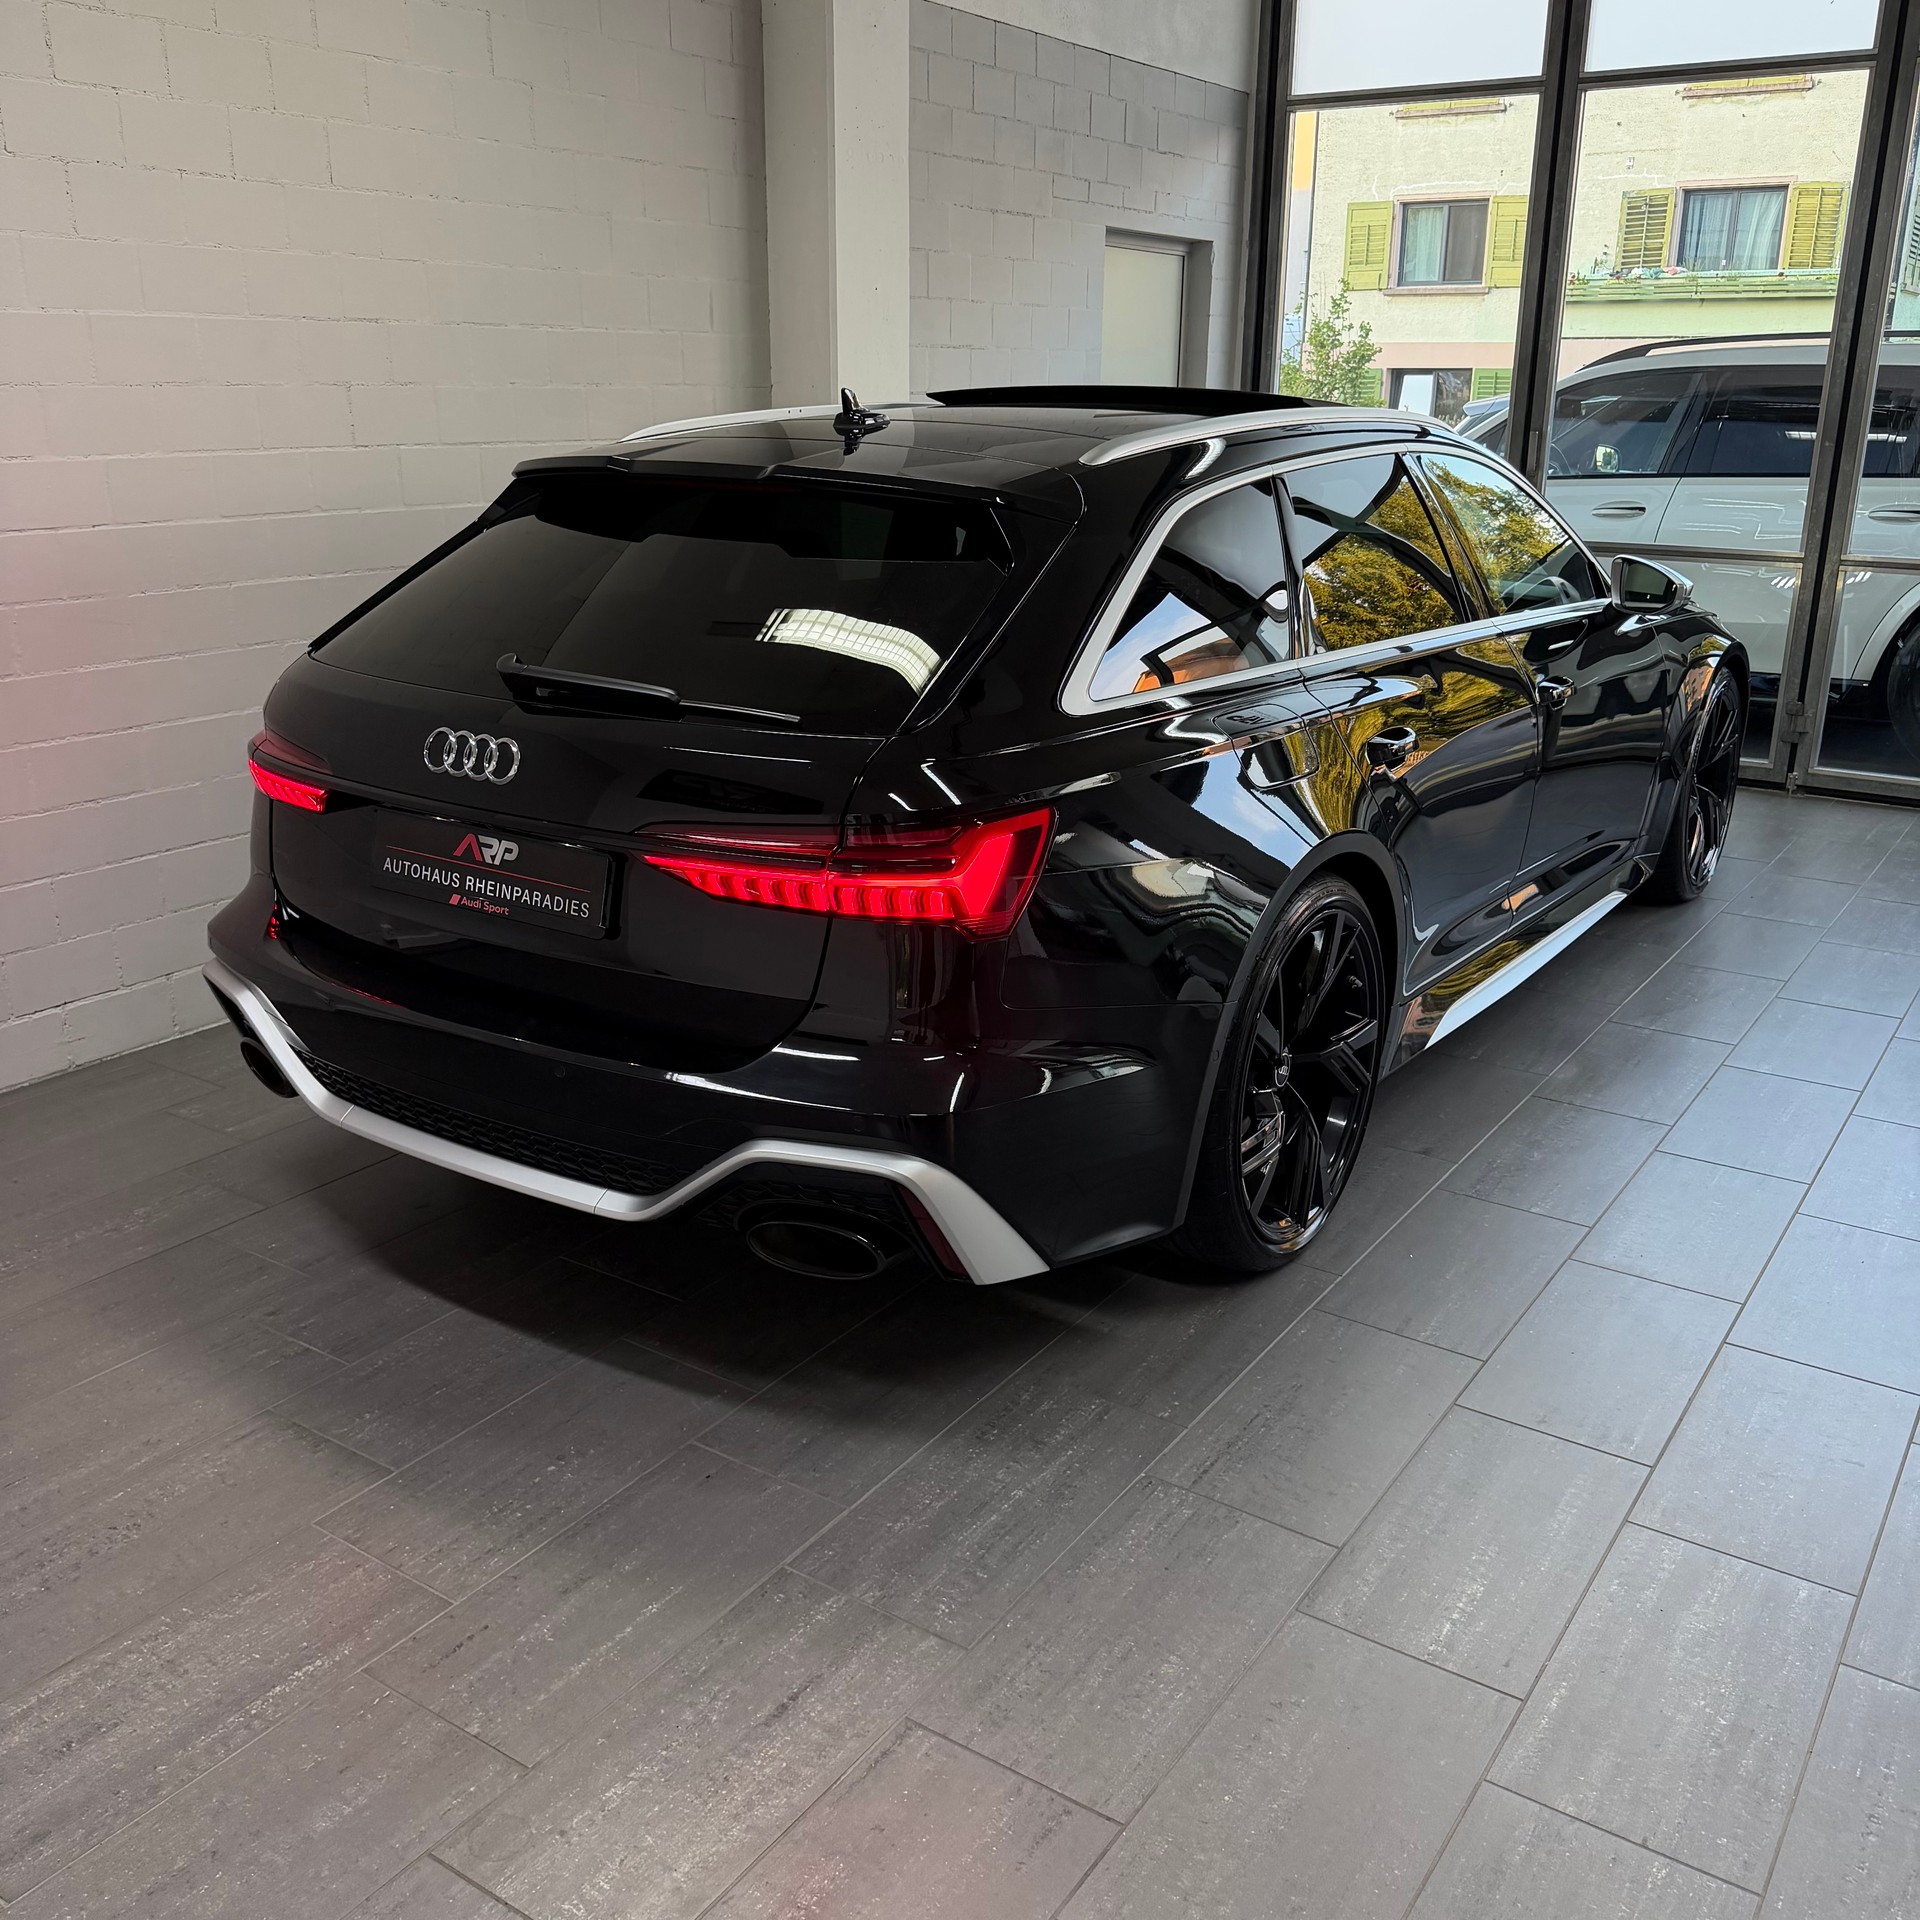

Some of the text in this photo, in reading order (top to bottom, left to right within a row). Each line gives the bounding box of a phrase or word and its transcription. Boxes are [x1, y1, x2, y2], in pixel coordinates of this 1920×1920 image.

[453, 833, 519, 865] ARP
[383, 857, 589, 918] AUTOHAUS RHEINPARADIES
[461, 896, 509, 915] Audi Sport
